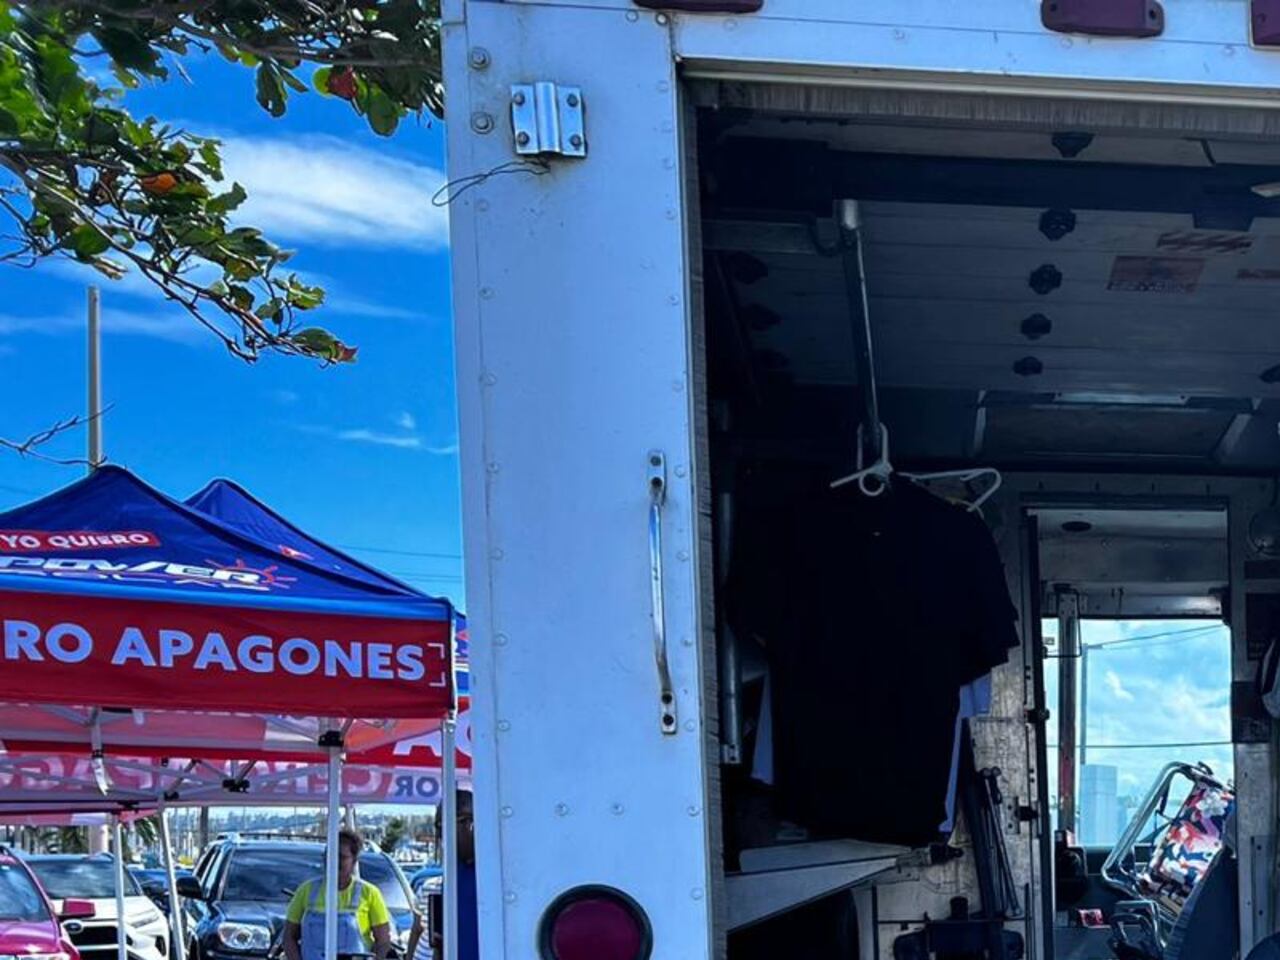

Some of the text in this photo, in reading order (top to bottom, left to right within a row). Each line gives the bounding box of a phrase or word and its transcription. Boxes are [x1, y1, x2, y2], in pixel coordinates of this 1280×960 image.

[1, 533, 150, 549] YO QUIERO
[111, 627, 425, 681] APAGONES
